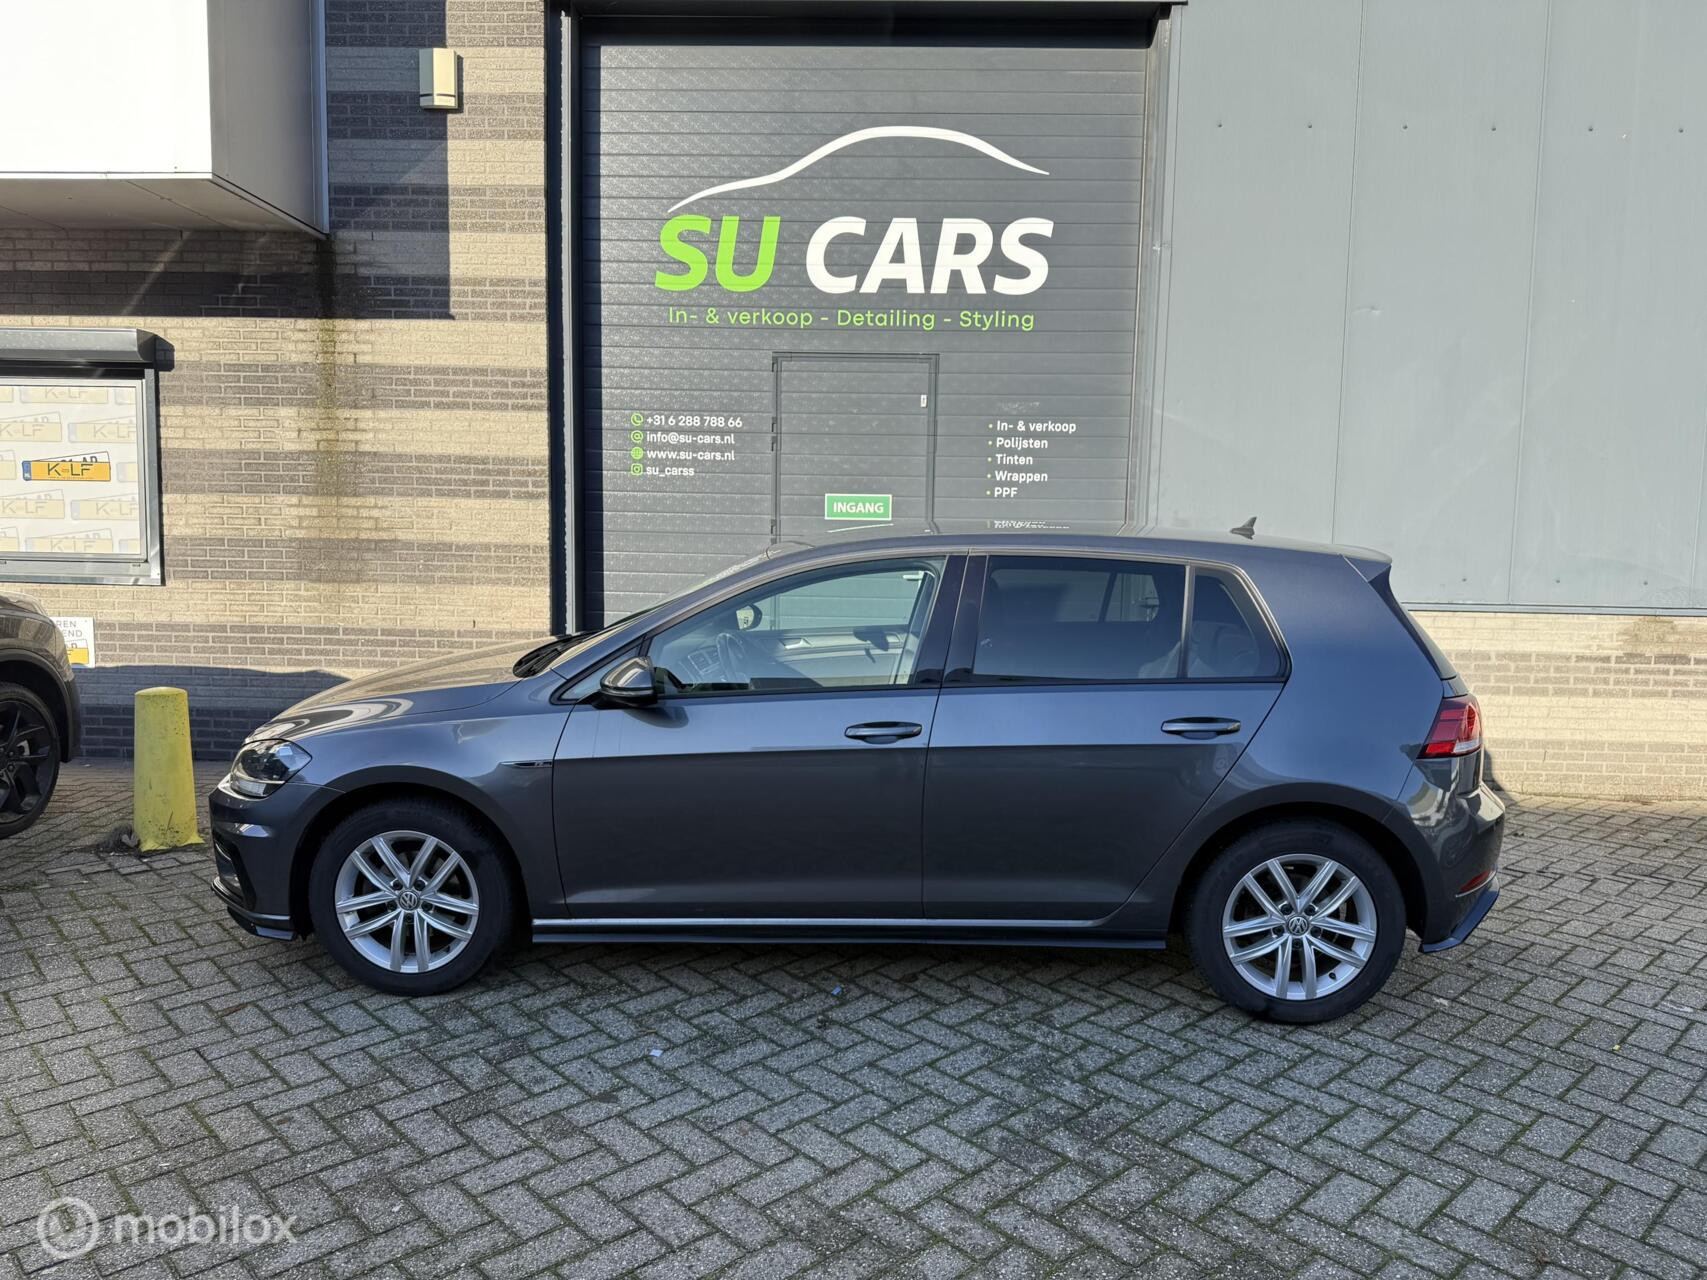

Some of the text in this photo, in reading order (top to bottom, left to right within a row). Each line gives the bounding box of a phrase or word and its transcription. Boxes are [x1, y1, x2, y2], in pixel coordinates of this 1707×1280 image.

[654, 214, 1055, 296] SU CARS
[668, 307, 698, 323] In-
[705, 307, 720, 324] &
[727, 308, 813, 329] verkoop
[837, 310, 935, 331] Detailing
[959, 310, 1034, 331] Styling
[646, 415, 743, 428] +31 6 288 788 66
[1017, 420, 1026, 431] &
[1029, 420, 1077, 434] verkoop
[646, 431, 735, 444] info@su-cars.nl
[996, 437, 1048, 450] Polijsten
[646, 450, 735, 461] www.su-cars.nl
[995, 453, 1033, 465] Tinten
[645, 466, 695, 477] su_carss
[994, 470, 1048, 484] Wrappen
[994, 487, 1018, 498] PPF
[833, 502, 884, 514] INGANG
